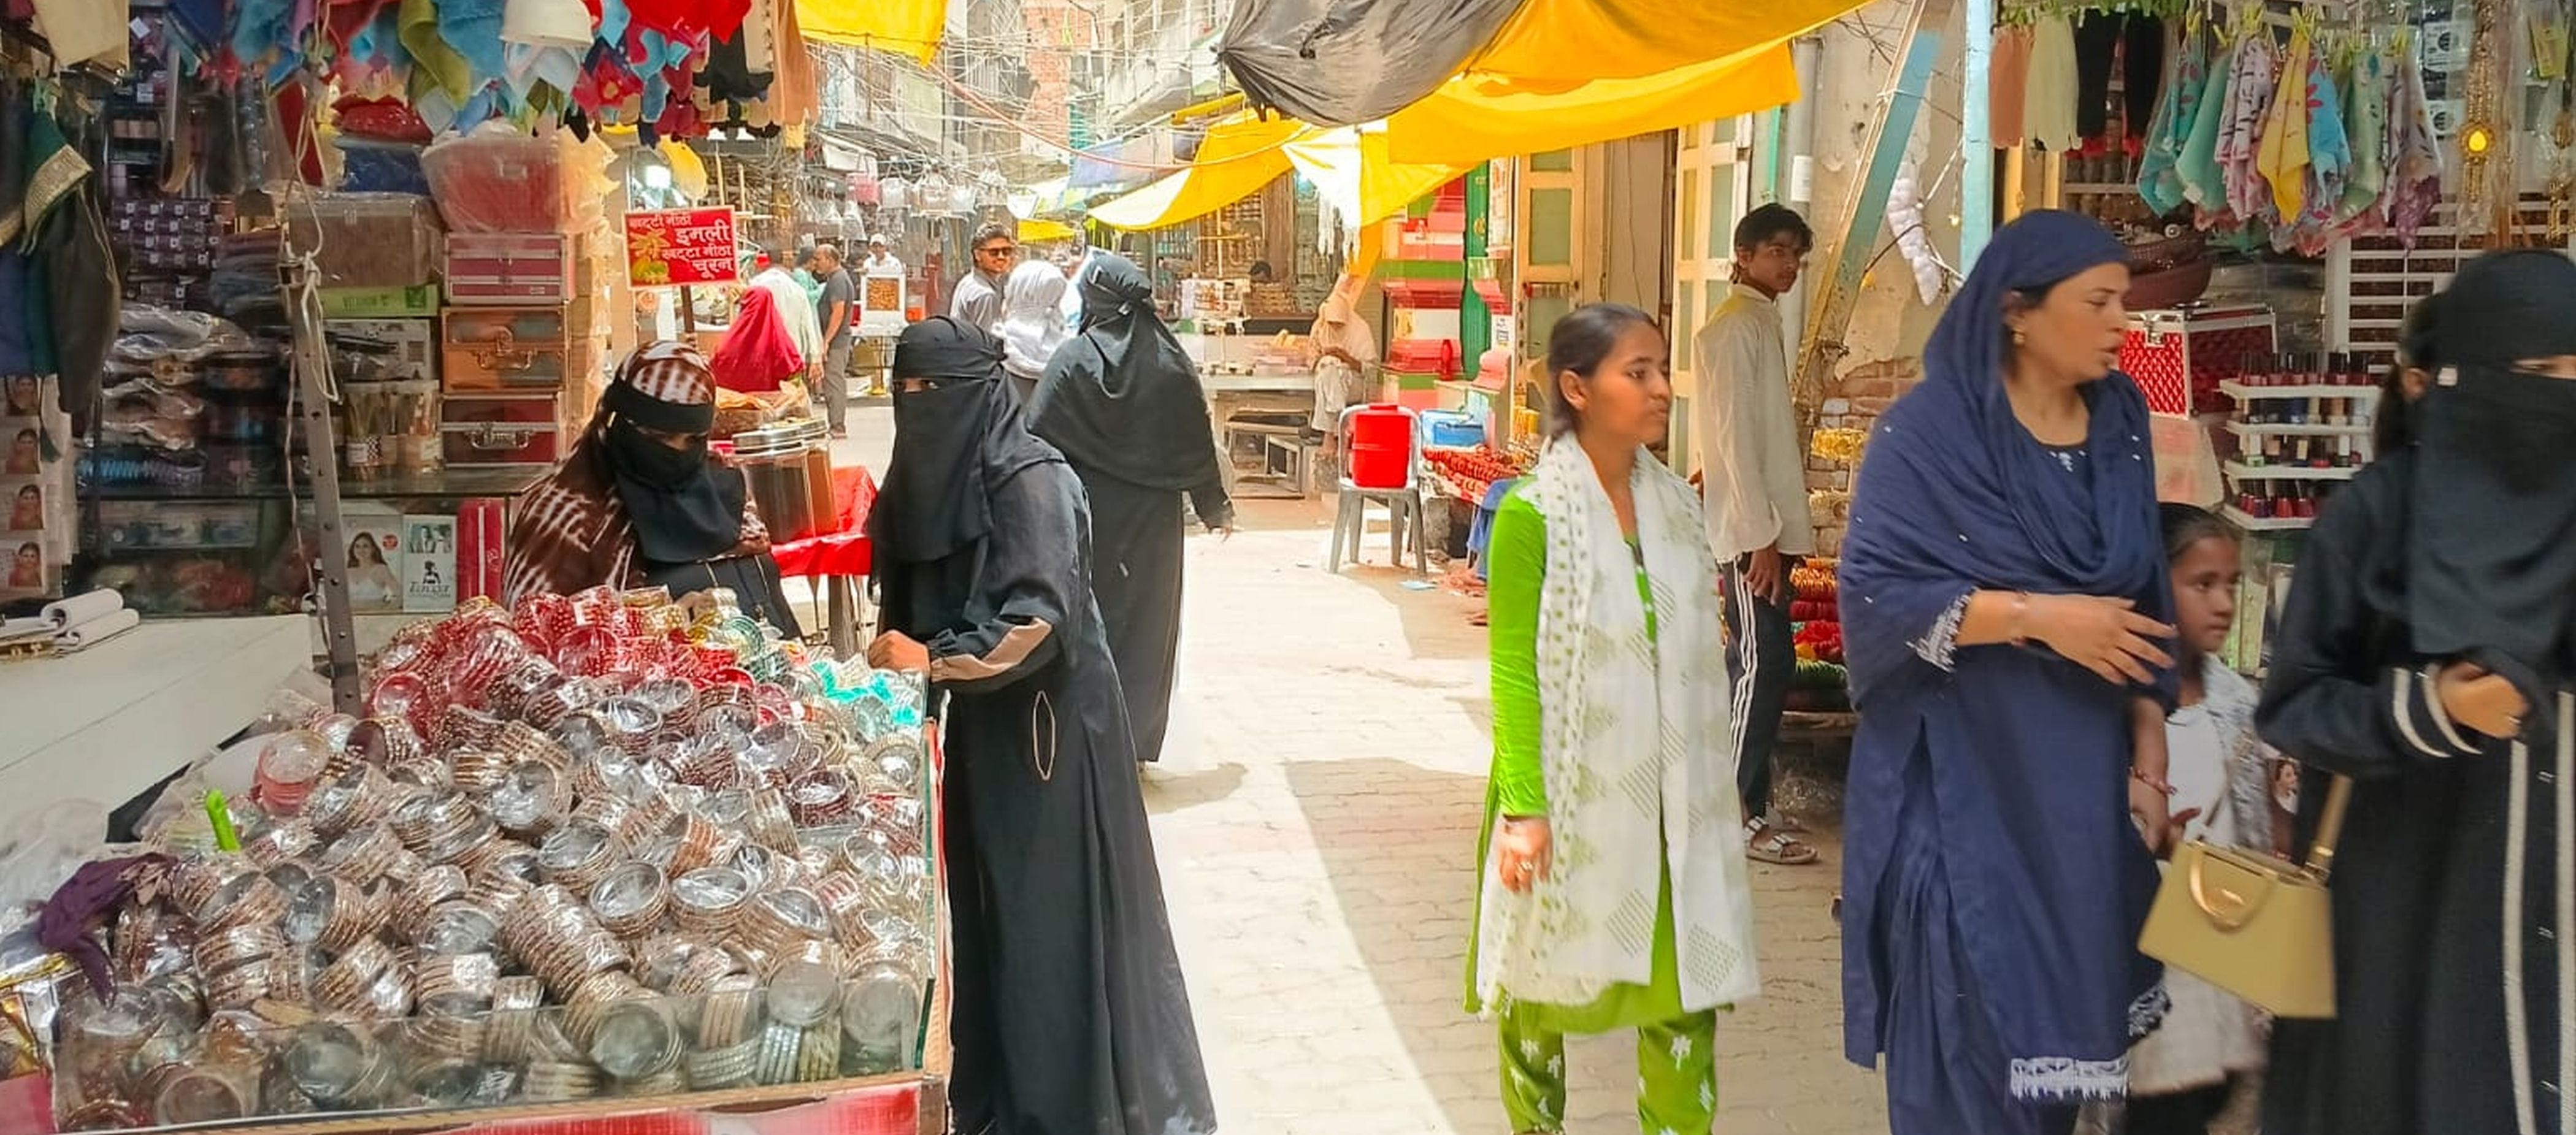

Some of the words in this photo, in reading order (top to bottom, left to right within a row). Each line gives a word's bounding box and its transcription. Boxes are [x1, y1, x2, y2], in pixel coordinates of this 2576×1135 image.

[675, 218, 730, 245] इमली
[662, 246, 701, 262] खट्टा
[692, 258, 734, 280] चूरन
